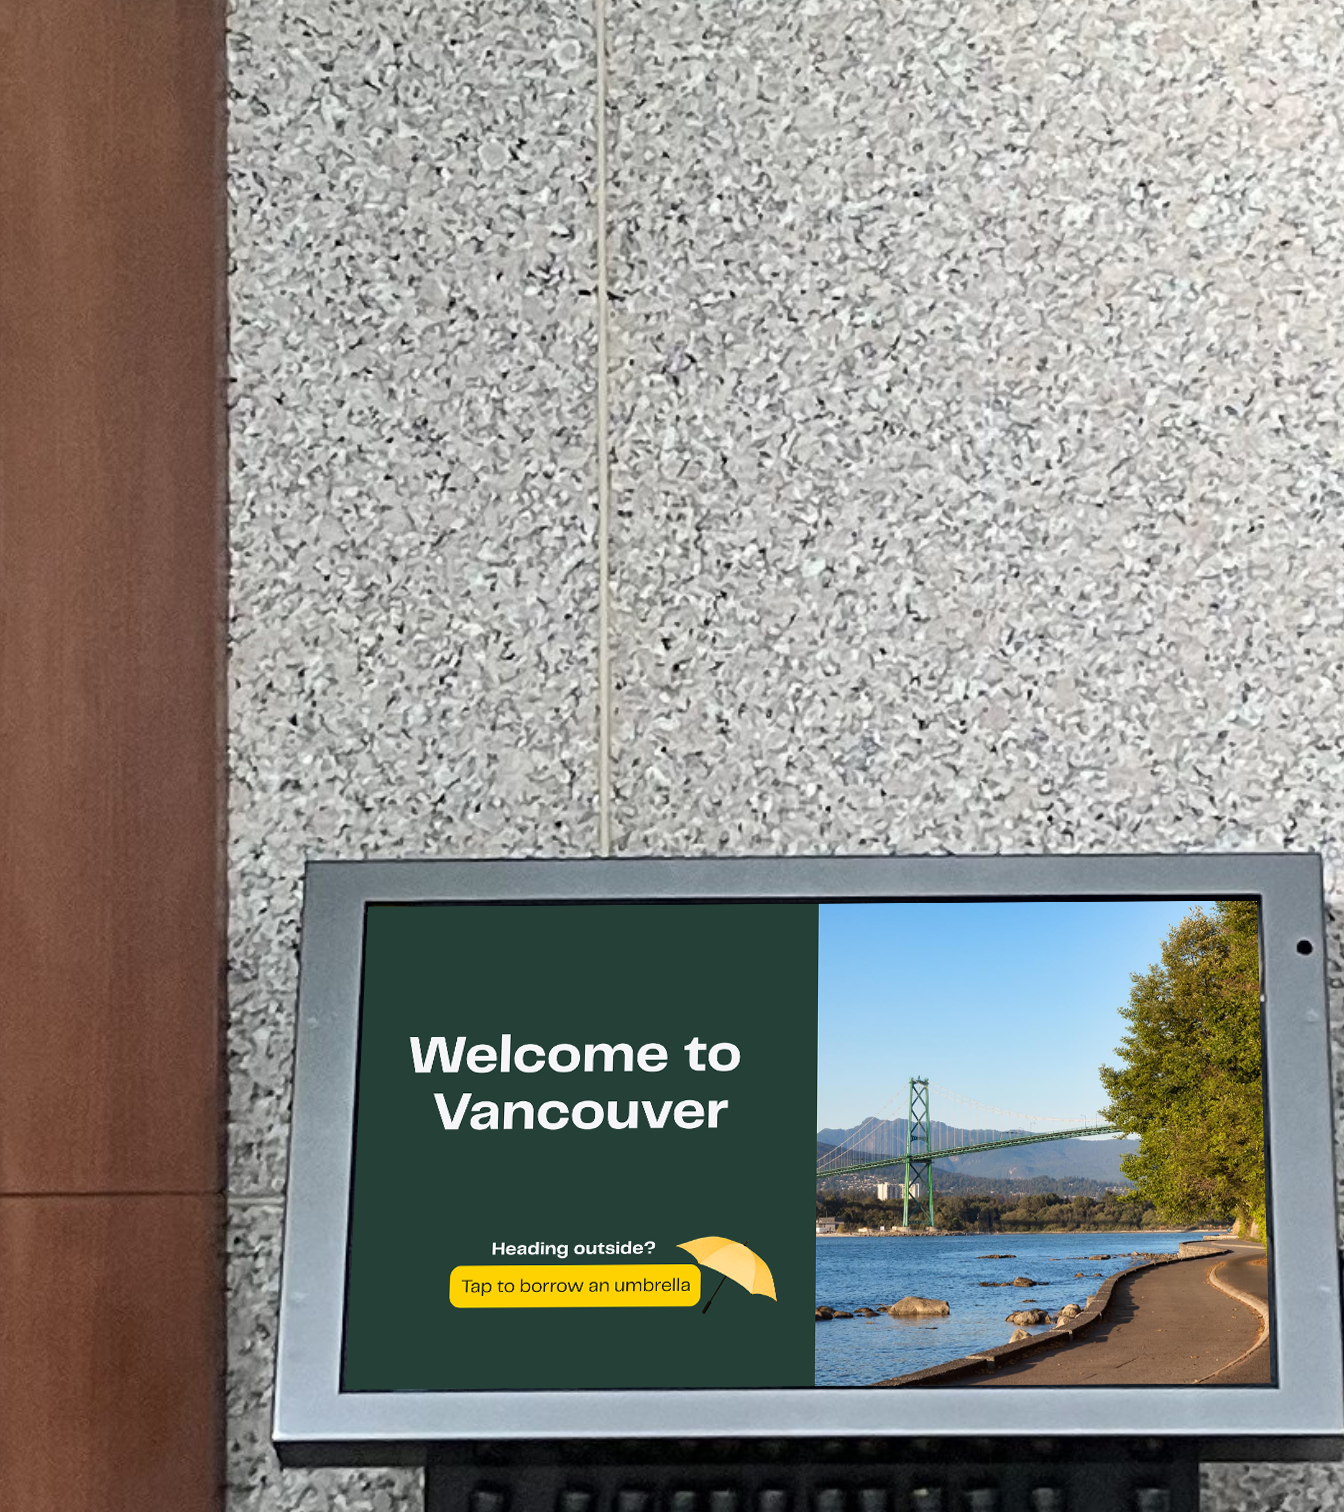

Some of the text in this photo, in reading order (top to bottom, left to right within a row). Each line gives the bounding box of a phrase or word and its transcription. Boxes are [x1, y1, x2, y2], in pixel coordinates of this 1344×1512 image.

[409, 1033, 741, 1074] Welcome to
[433, 1092, 729, 1131] Vancouver
[491, 1240, 656, 1260] Heading outside?
[461, 1277, 691, 1298] Tap to borrow an umbrella
